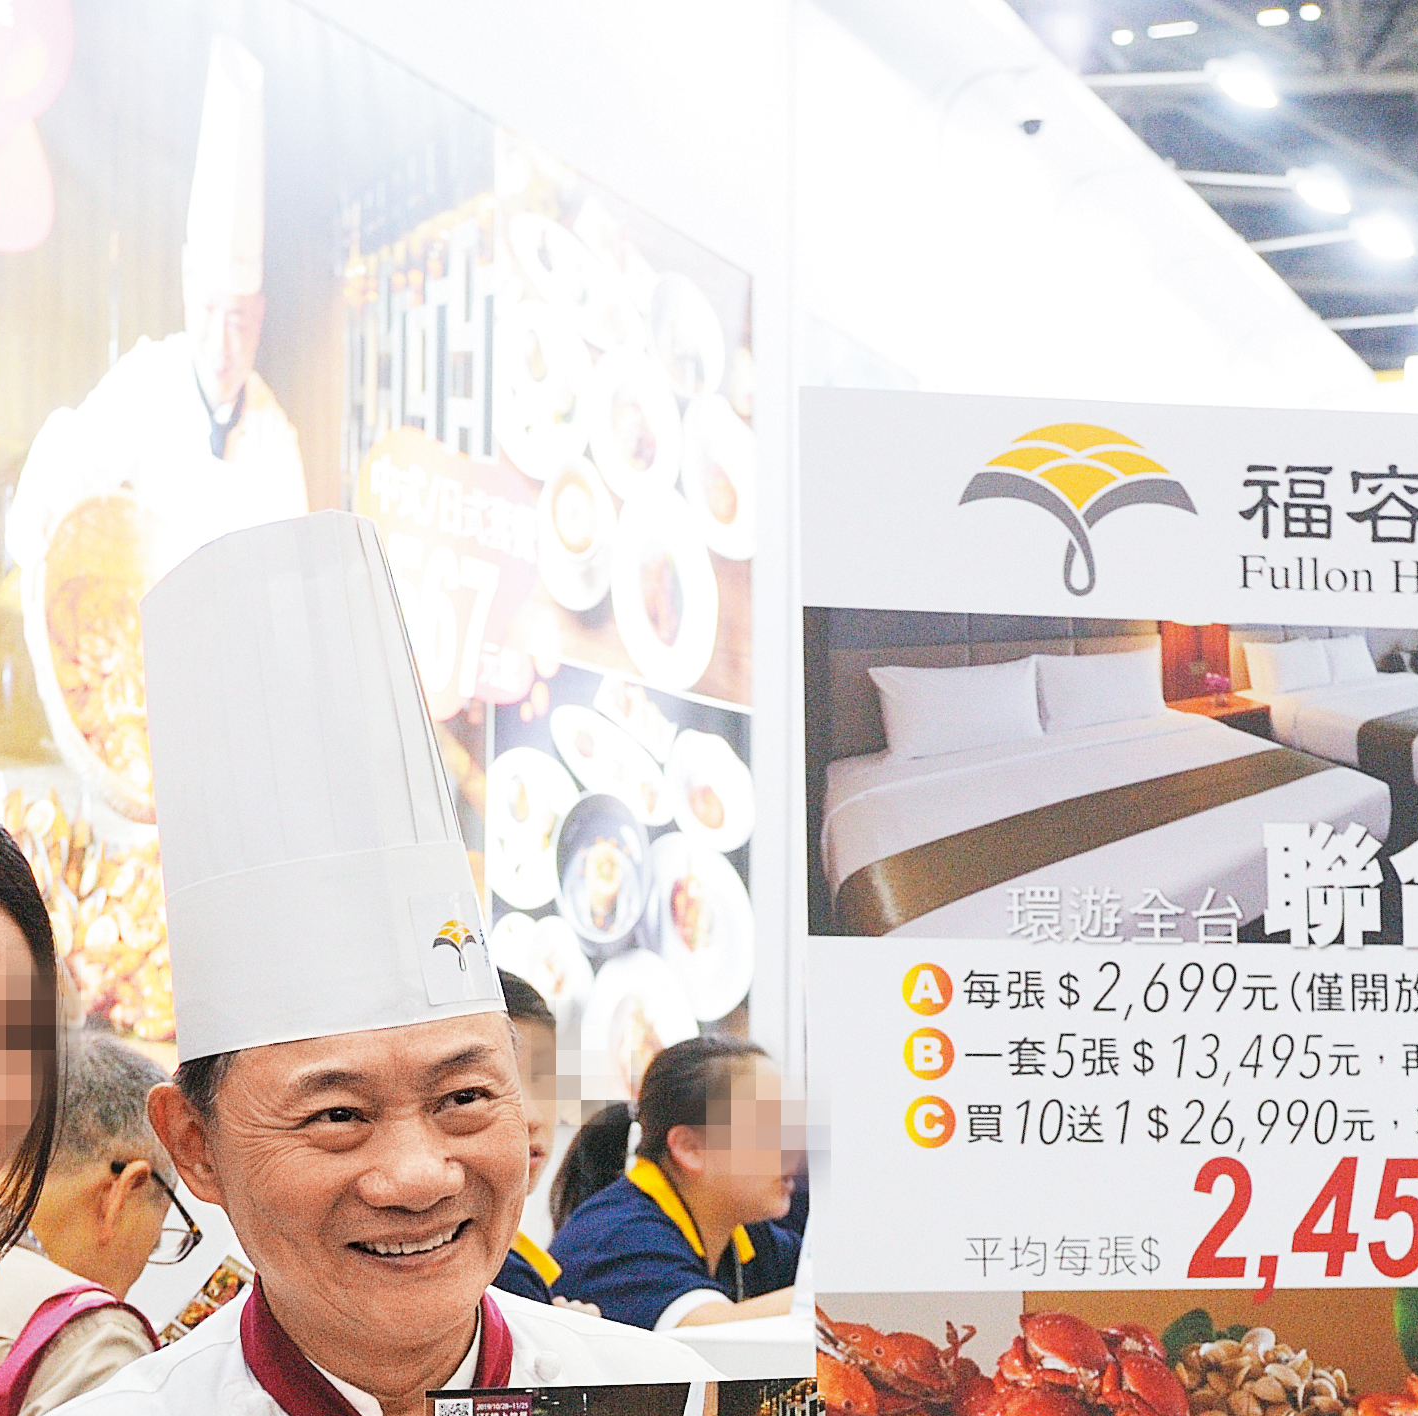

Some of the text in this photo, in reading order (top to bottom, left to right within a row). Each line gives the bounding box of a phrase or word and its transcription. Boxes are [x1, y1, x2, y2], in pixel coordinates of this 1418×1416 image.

[1241, 555, 1372, 592] Fullon
[1005, 884, 1246, 949] 環遊全台
[909, 970, 944, 1004] A
[913, 1036, 944, 1071] B
[913, 1103, 946, 1138] C
[965, 1236, 1160, 1277] 平均每張$
